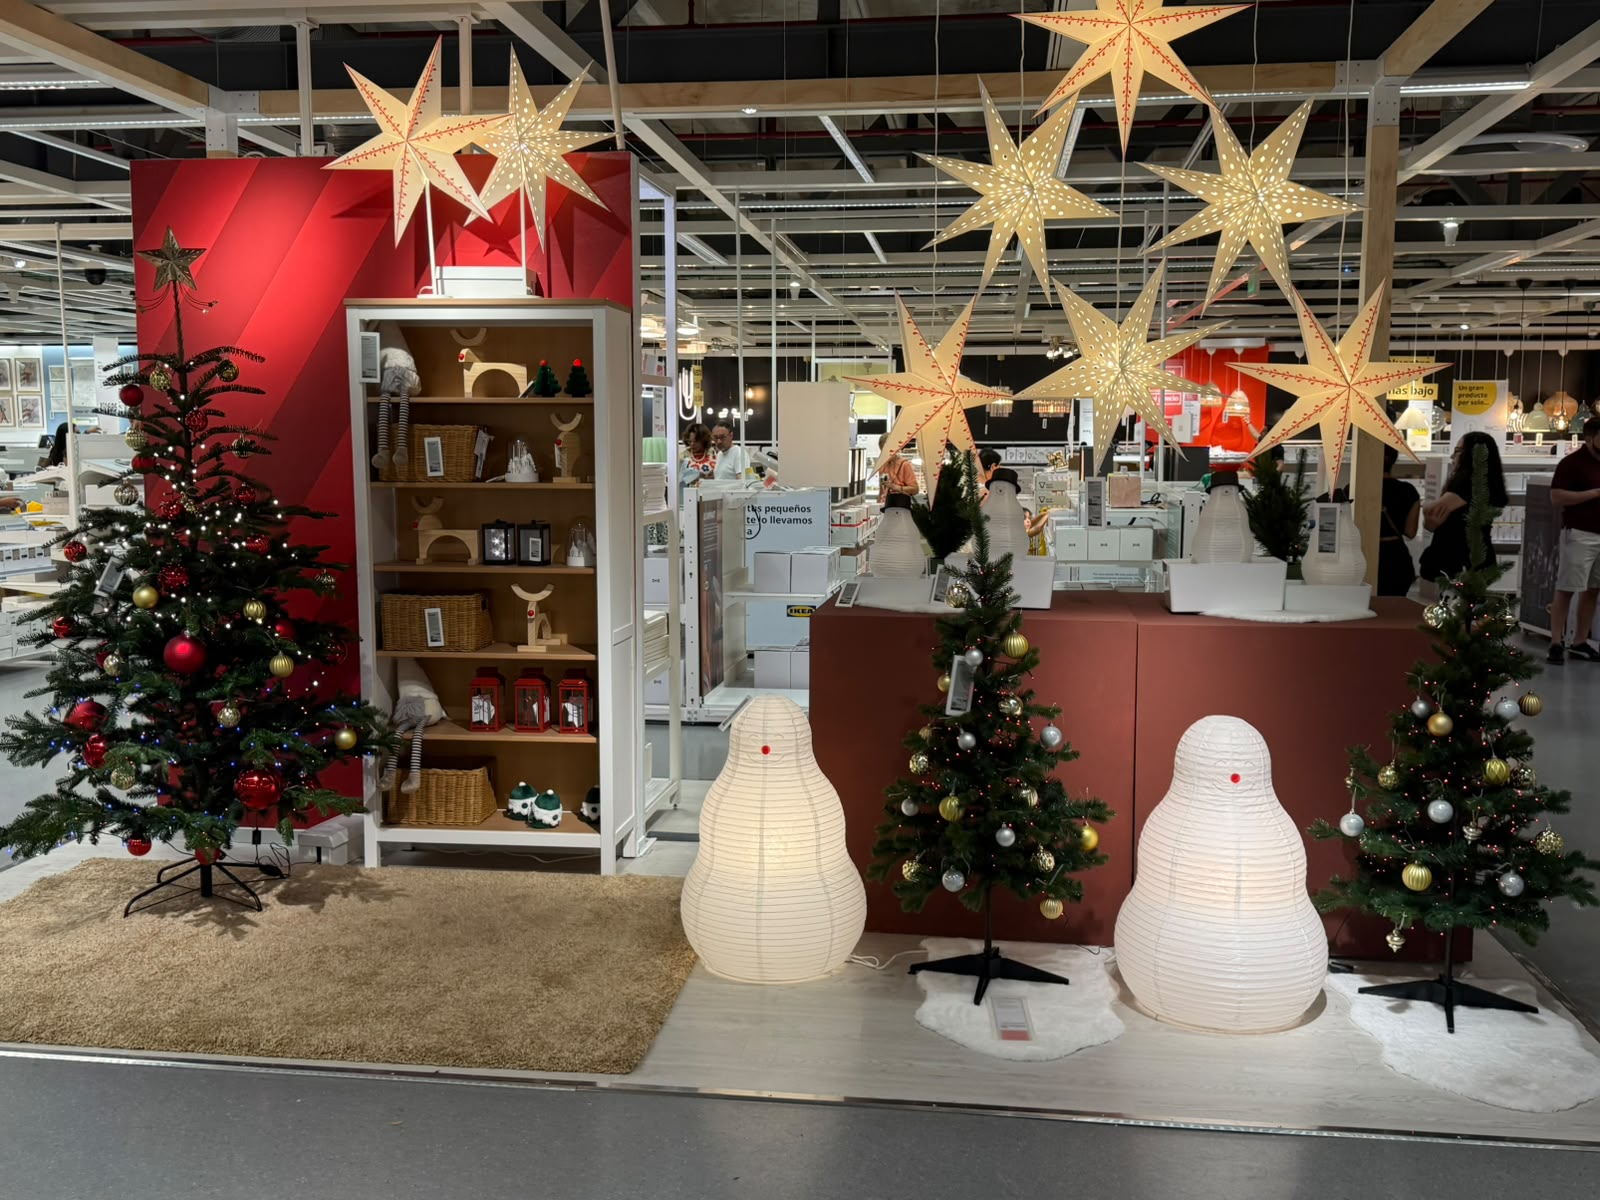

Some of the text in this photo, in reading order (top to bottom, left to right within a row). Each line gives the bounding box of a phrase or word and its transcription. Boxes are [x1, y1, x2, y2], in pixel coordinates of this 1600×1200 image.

[1410, 385, 1434, 398] bajo
[764, 504, 812, 514] pequeños
[770, 516, 813, 525] llevamos
